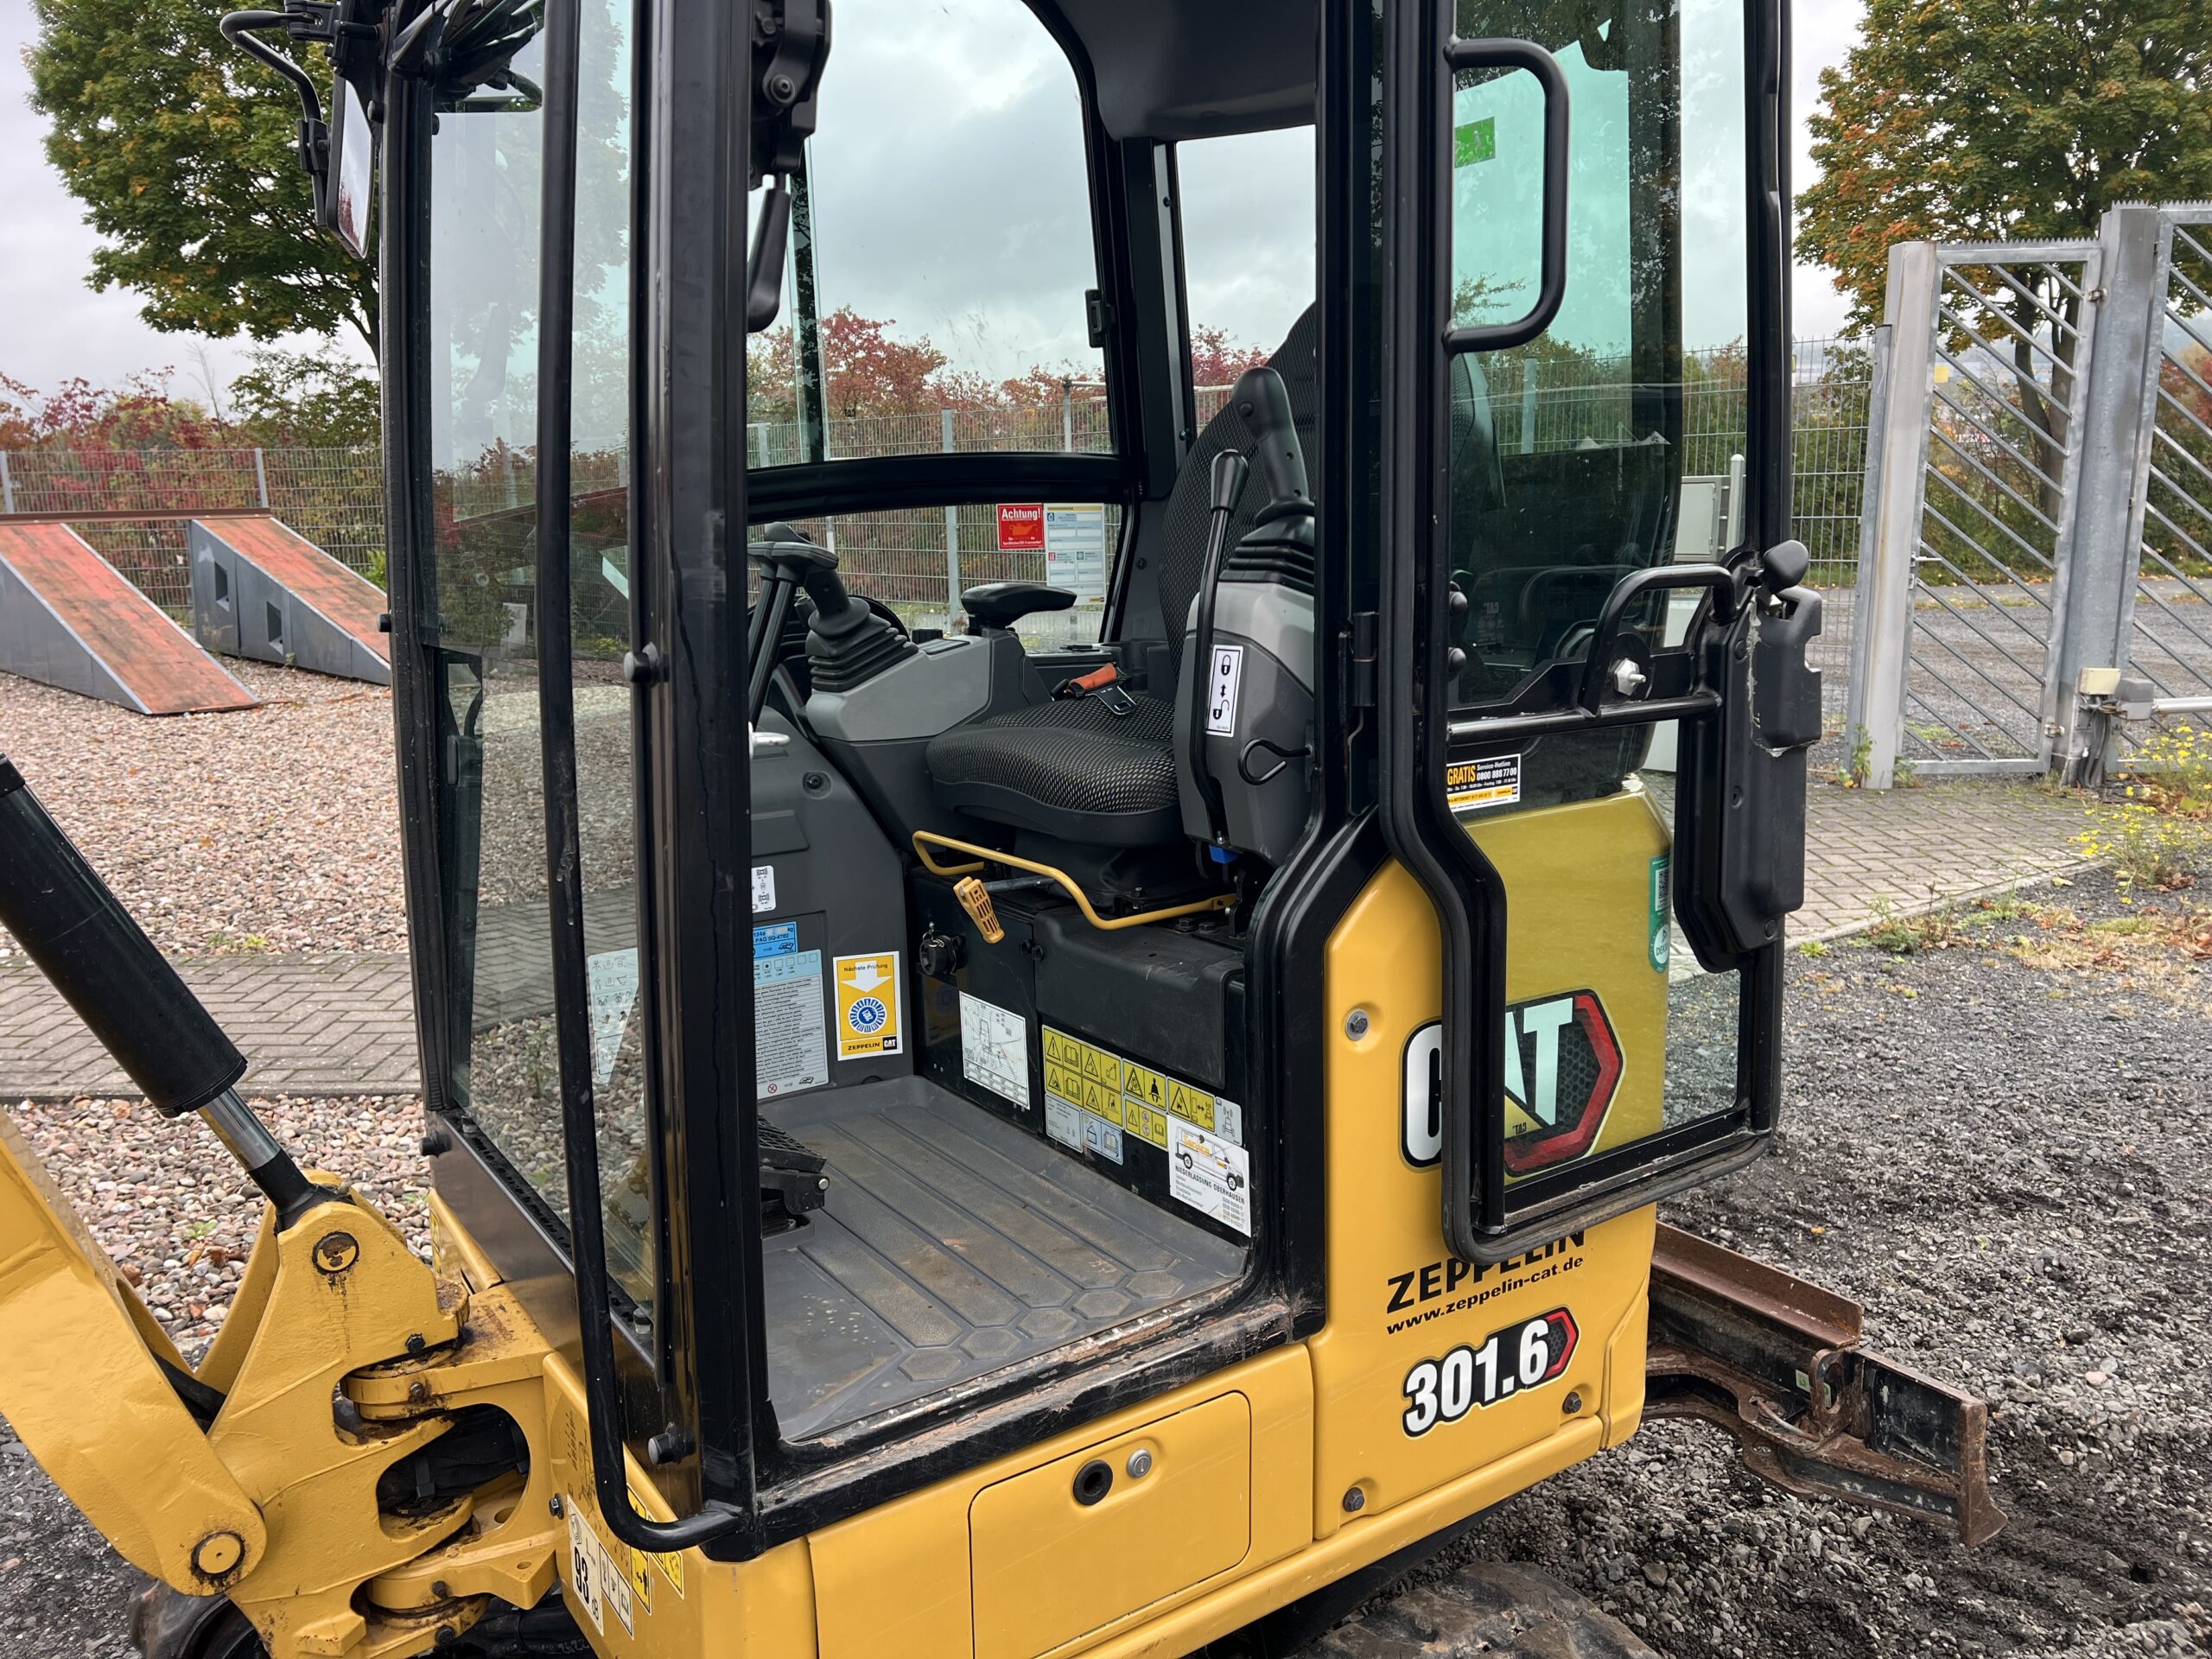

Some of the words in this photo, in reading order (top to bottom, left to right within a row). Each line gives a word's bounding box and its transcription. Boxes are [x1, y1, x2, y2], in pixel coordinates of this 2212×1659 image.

[1001, 507, 1041, 521] Achtung!
[1447, 765, 1476, 785] GRATIS
[848, 1042, 880, 1051] ZEPPELIN
[884, 1039, 896, 1048] CAT
[1183, 1133, 1211, 1157] Service
[1175, 1165, 1212, 1189] NIEDERLASSUNG
[1213, 1184, 1245, 1205] OBERHAUSEN
[1387, 1256, 1584, 1335] www.zeppelin-cat.de
[1405, 1319, 1549, 1433] 301.6
[575, 1546, 589, 1605] 93
